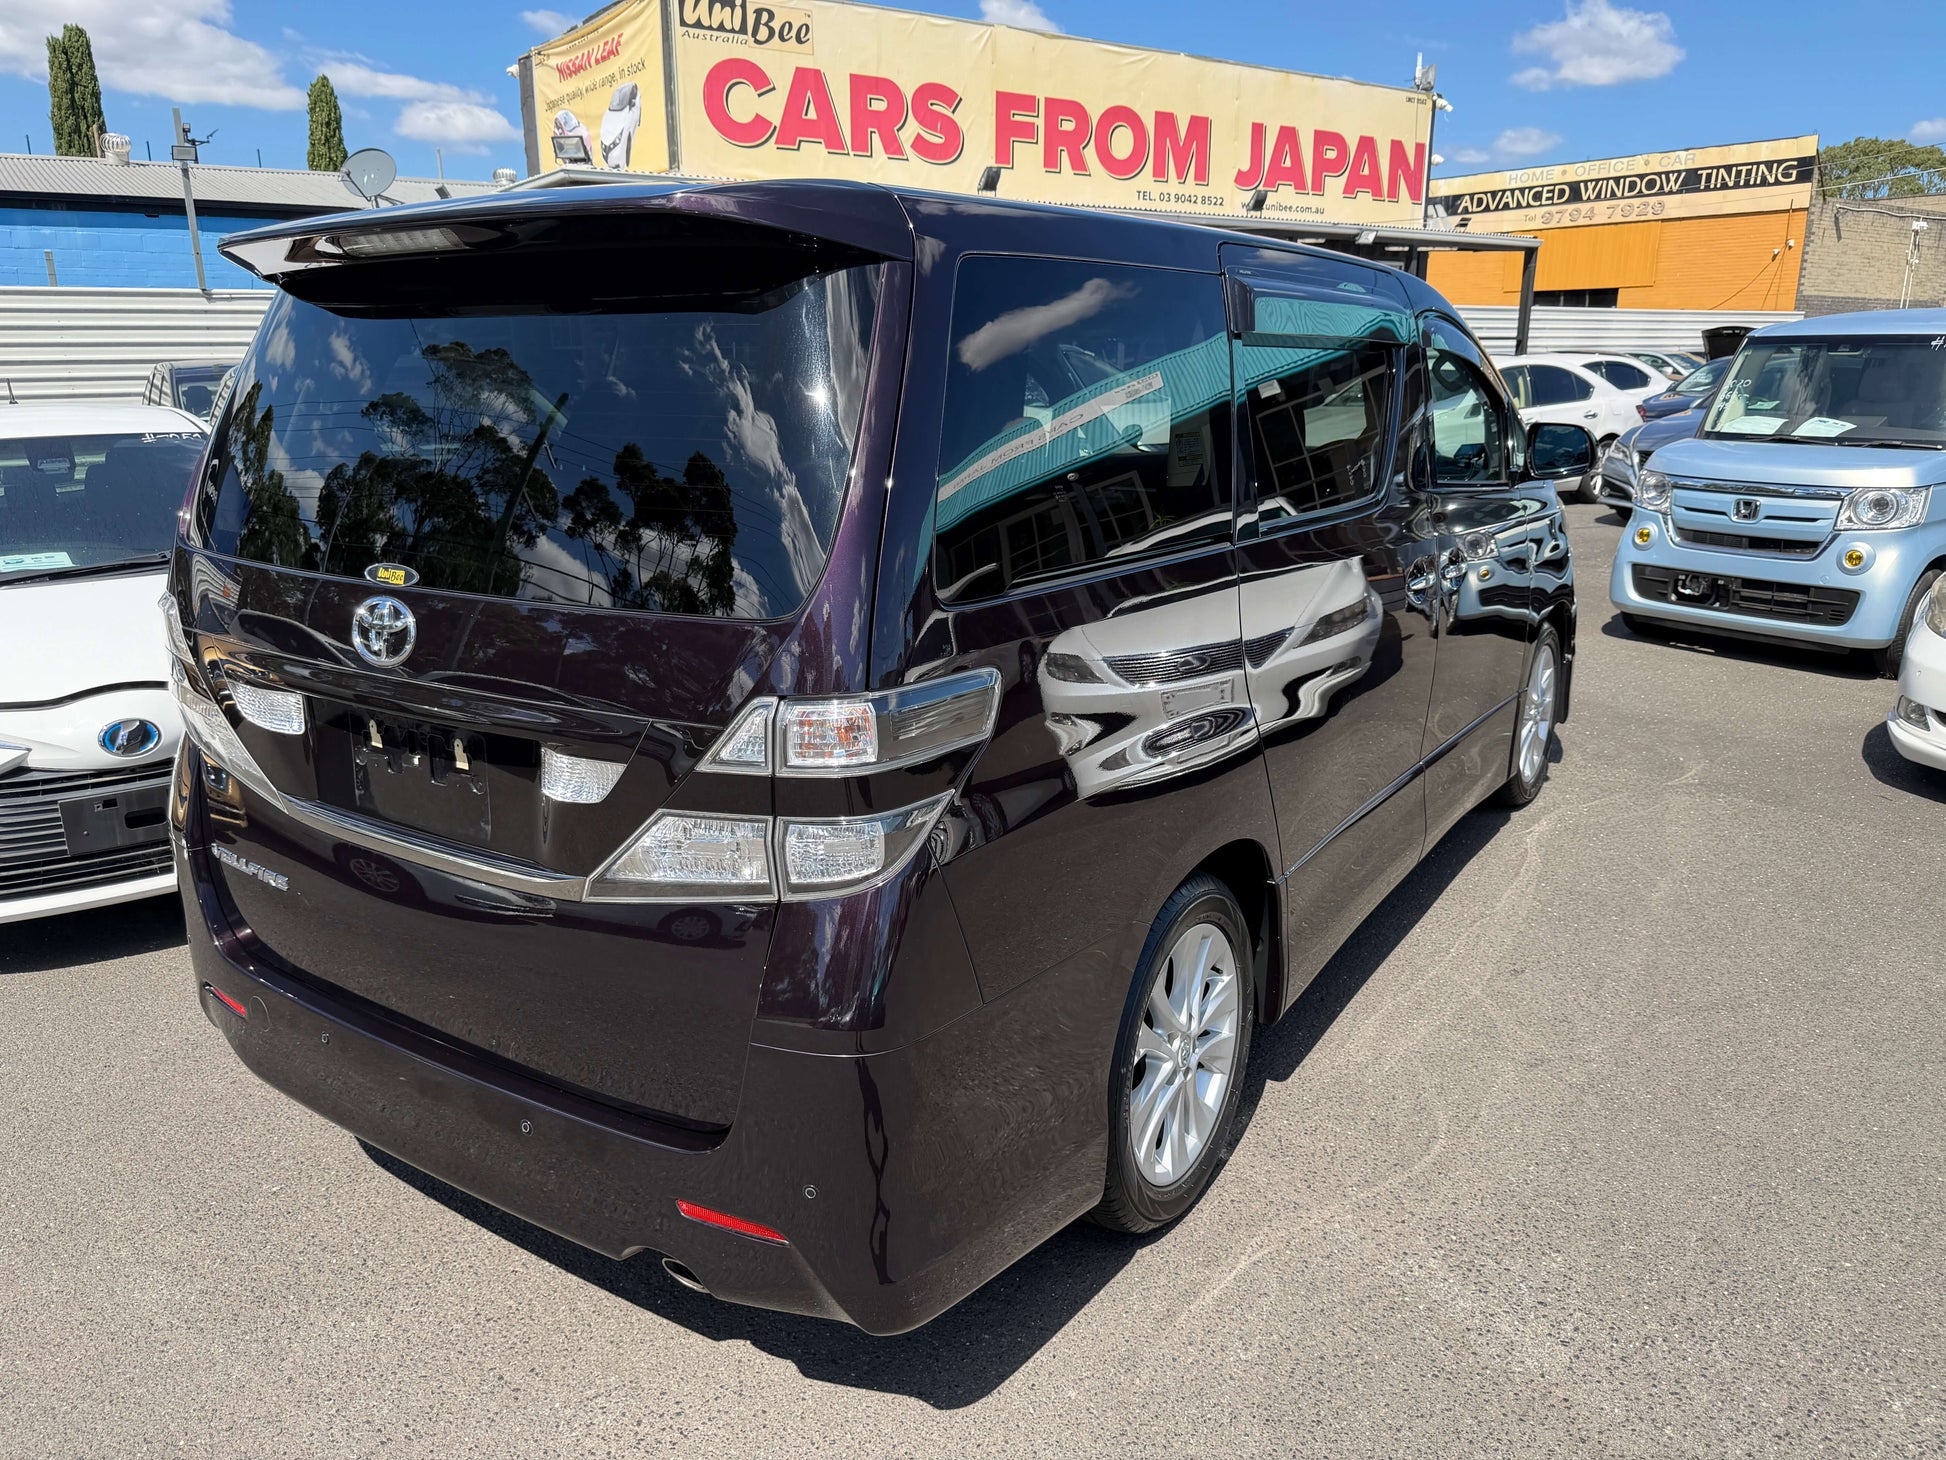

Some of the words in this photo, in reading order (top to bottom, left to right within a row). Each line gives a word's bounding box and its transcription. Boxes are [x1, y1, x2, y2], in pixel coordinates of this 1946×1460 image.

[556, 46, 595, 83] NISSAN
[594, 32, 624, 66] LEAF
[681, 29, 748, 46] Australia
[545, 96, 566, 112] Japanese
[585, 78, 598, 94] wide
[618, 66, 626, 80] in
[627, 56, 647, 77] stock
[703, 57, 964, 165] CARS
[995, 90, 1211, 186] FROM
[1233, 121, 1427, 205] JAPAN
[1457, 184, 1570, 214] ADVANCED
[1580, 171, 1686, 202] WINDOW
[1697, 160, 1798, 190] TINTING
[1508, 168, 1556, 186] HOME
[1574, 158, 1637, 177] OFFICE
[1658, 152, 1697, 168] CAR
[1136, 190, 1156, 203] TEL.
[1158, 192, 1172, 203] 03
[1174, 194, 1198, 205] 9042
[1200, 195, 1225, 207] 8522
[1541, 206, 1596, 225] 9794
[1606, 199, 1666, 219] 7929
